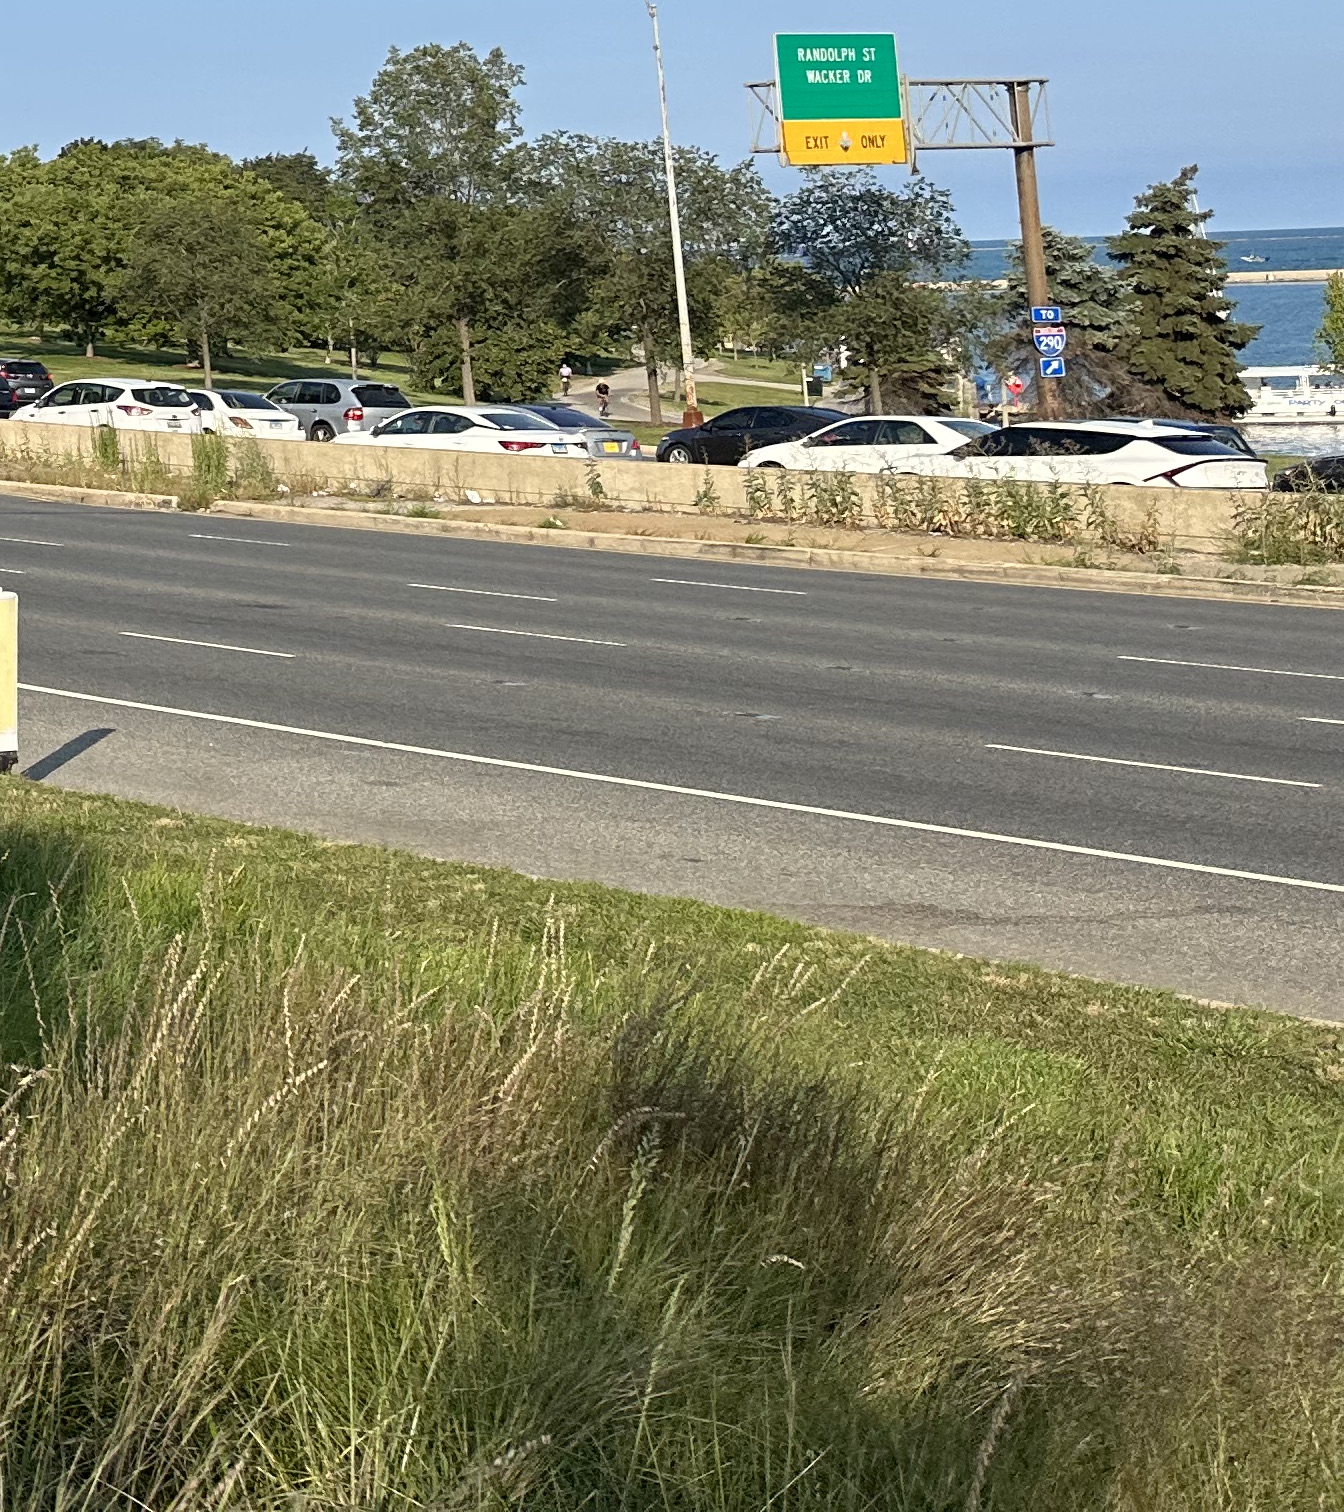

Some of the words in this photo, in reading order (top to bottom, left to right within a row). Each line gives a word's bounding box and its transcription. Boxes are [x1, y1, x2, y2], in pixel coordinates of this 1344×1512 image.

[797, 47, 856, 62] RANDOLPH
[862, 47, 876, 62] ST
[805, 69, 851, 84] WACKER
[857, 69, 872, 84] DR
[805, 135, 830, 150] EXIT
[860, 134, 887, 149] ONLY
[1039, 310, 1054, 319] TO
[1039, 336, 1062, 350] 290
